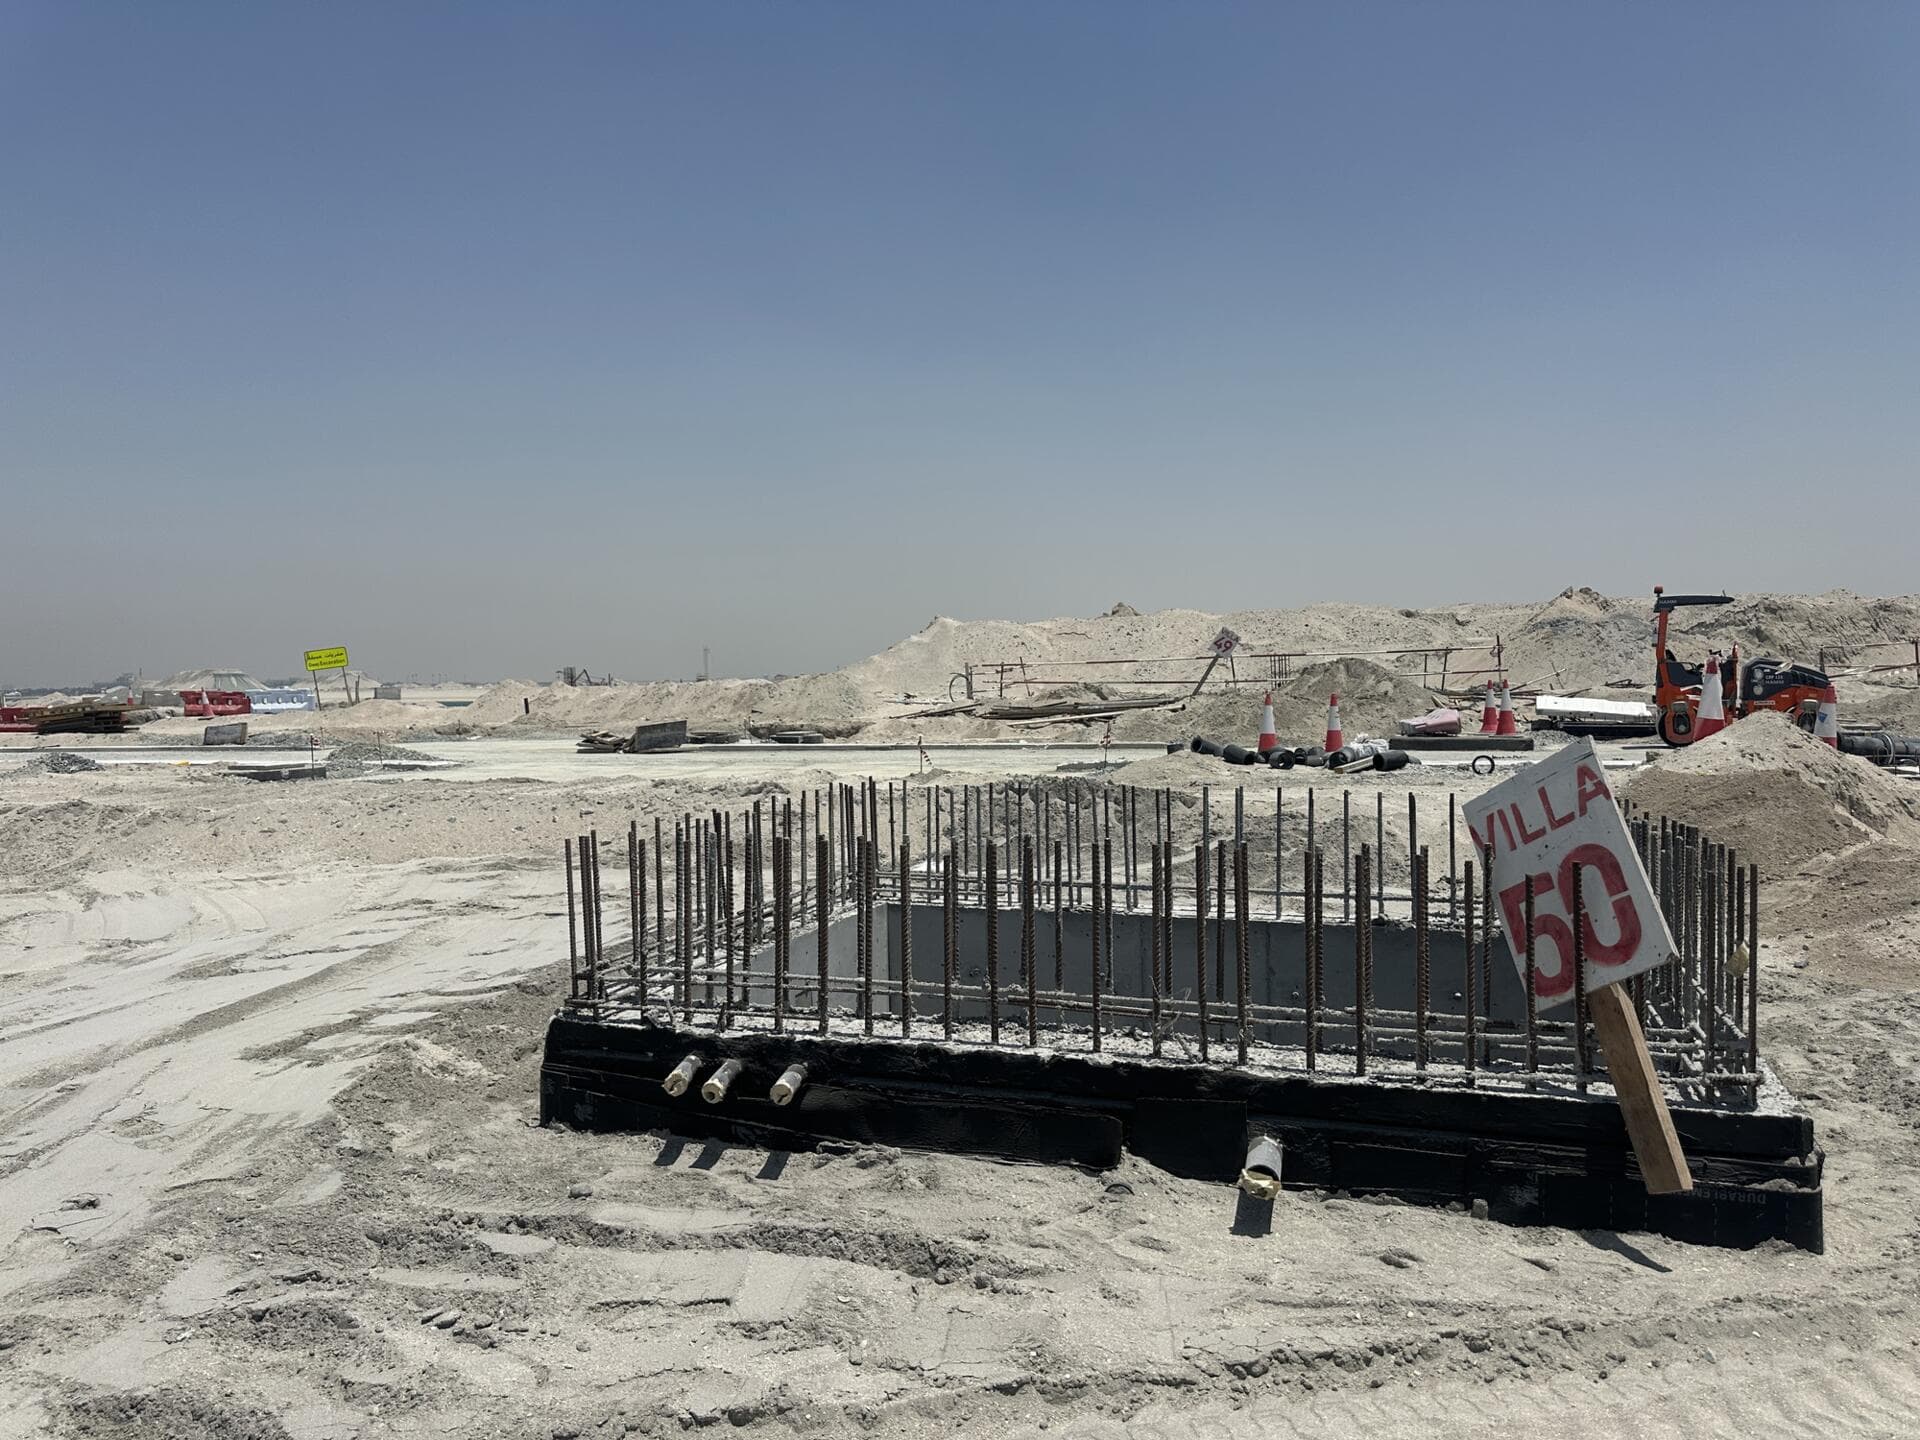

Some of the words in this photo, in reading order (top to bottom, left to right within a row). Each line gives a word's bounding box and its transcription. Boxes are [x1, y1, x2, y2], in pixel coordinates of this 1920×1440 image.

[1213, 637, 1233, 653] 49
[1469, 763, 1612, 861] VILLA
[1498, 843, 1642, 998] 50
